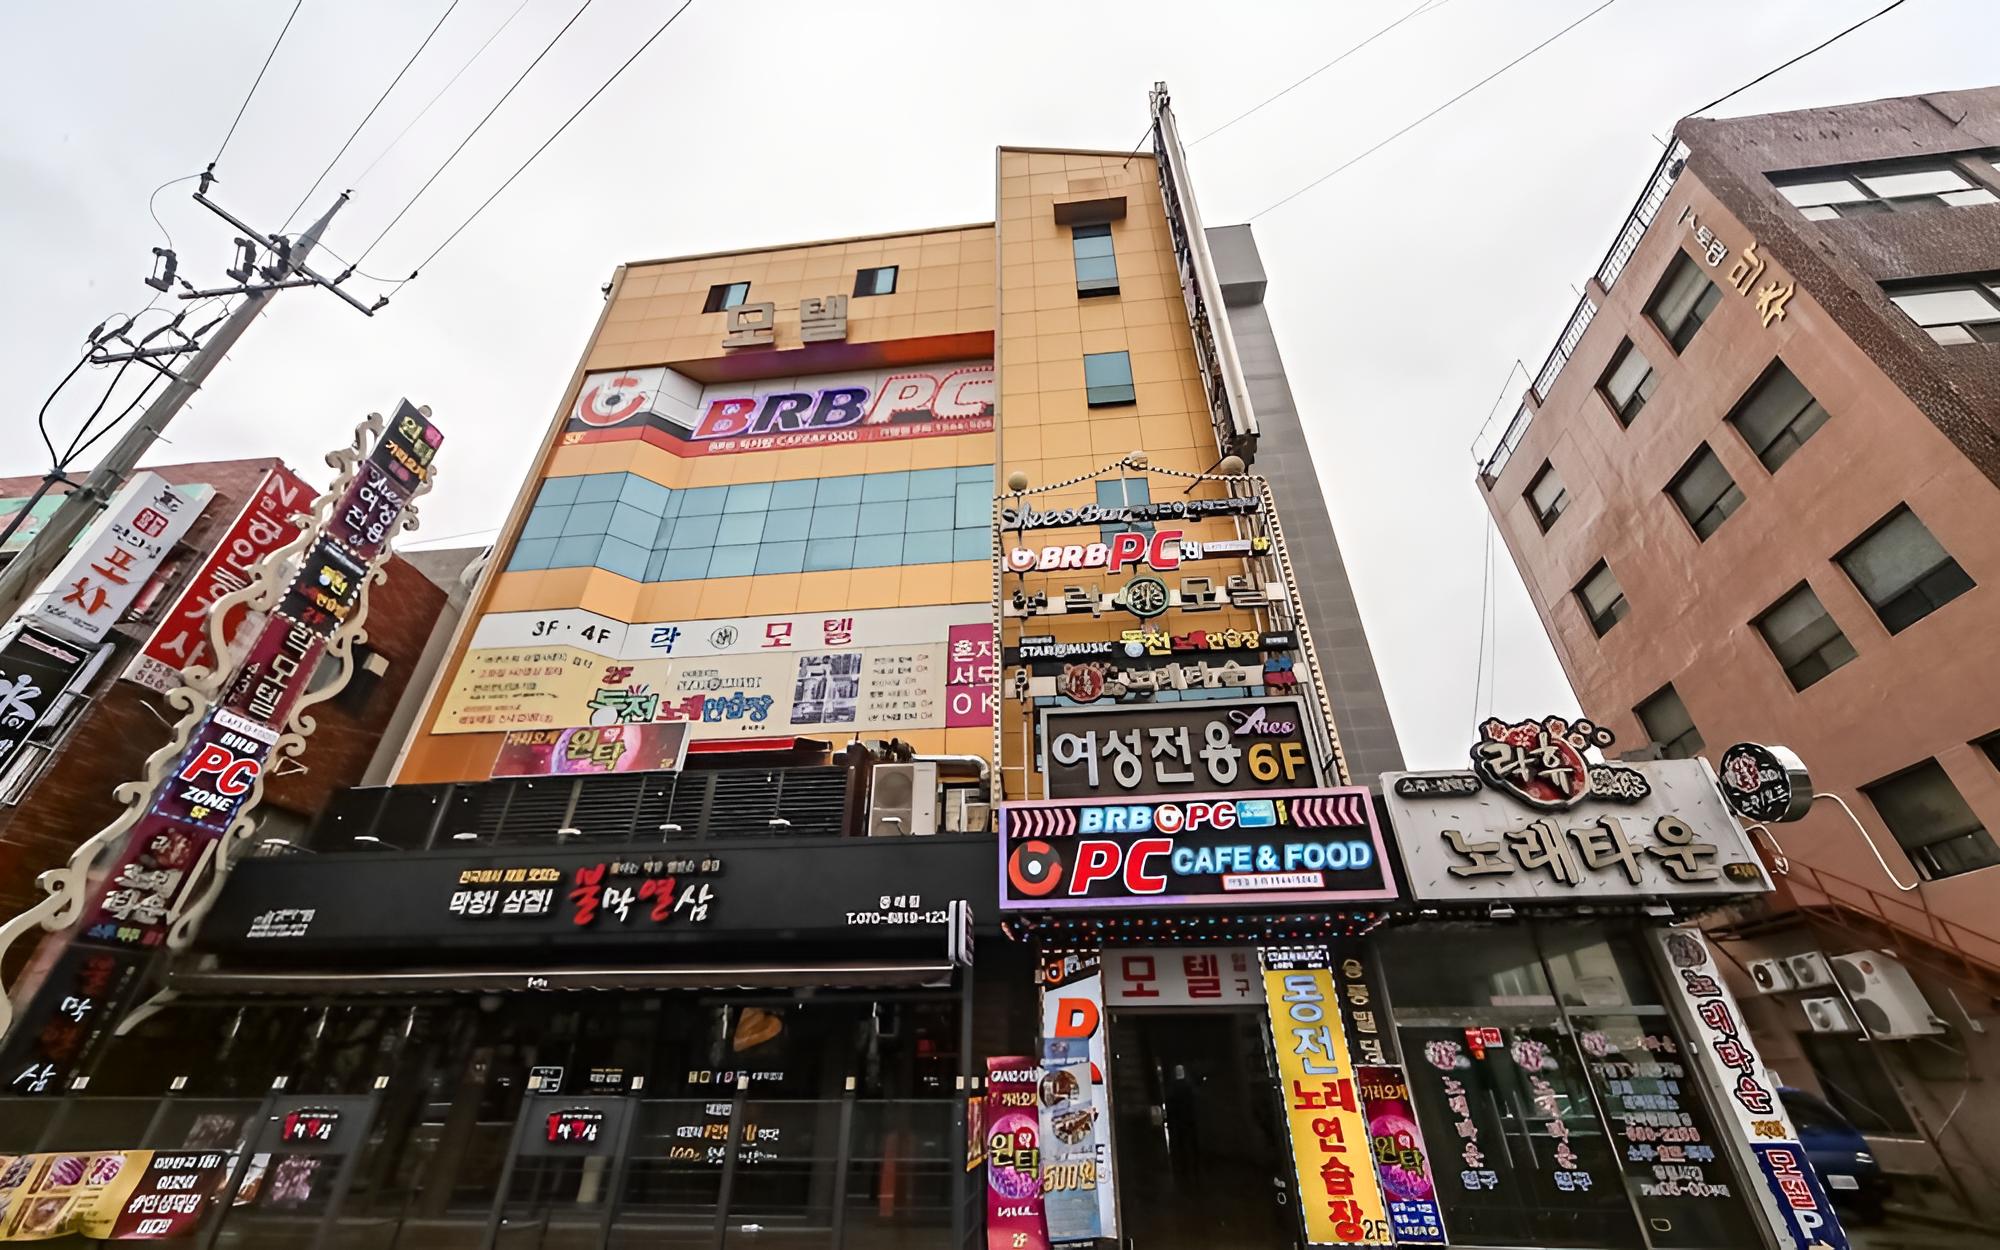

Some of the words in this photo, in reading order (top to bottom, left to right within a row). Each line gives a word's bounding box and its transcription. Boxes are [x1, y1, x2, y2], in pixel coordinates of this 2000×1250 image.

[722, 294, 849, 350] 모텔
[690, 385, 871, 441] BRB
[866, 364, 995, 427] PC
[1037, 542, 1107, 571] BRB
[1108, 531, 1183, 573] PC
[61, 544, 138, 615] 포차
[581, 624, 611, 644] 4F
[760, 616, 854, 649] 모텔
[179, 743, 263, 797] PC
[1051, 719, 1242, 789] 여성전용
[1247, 742, 1306, 782] 6F
[180, 785, 236, 813] ZONE
[1079, 806, 1153, 834] BRB
[1185, 802, 1238, 832] PC
[1068, 837, 1175, 896] PC
[1170, 845, 1253, 875] CAFE
[1254, 843, 1281, 873] &
[1283, 841, 1373, 873] FOOD
[1439, 814, 1719, 888] 노래타운
[449, 889, 500, 915] 막창!
[1120, 953, 1224, 999] 모텔
[1765, 1149, 1818, 1210] 모텔
[1792, 1209, 1824, 1240] P
[1362, 1219, 1390, 1242] 2F
